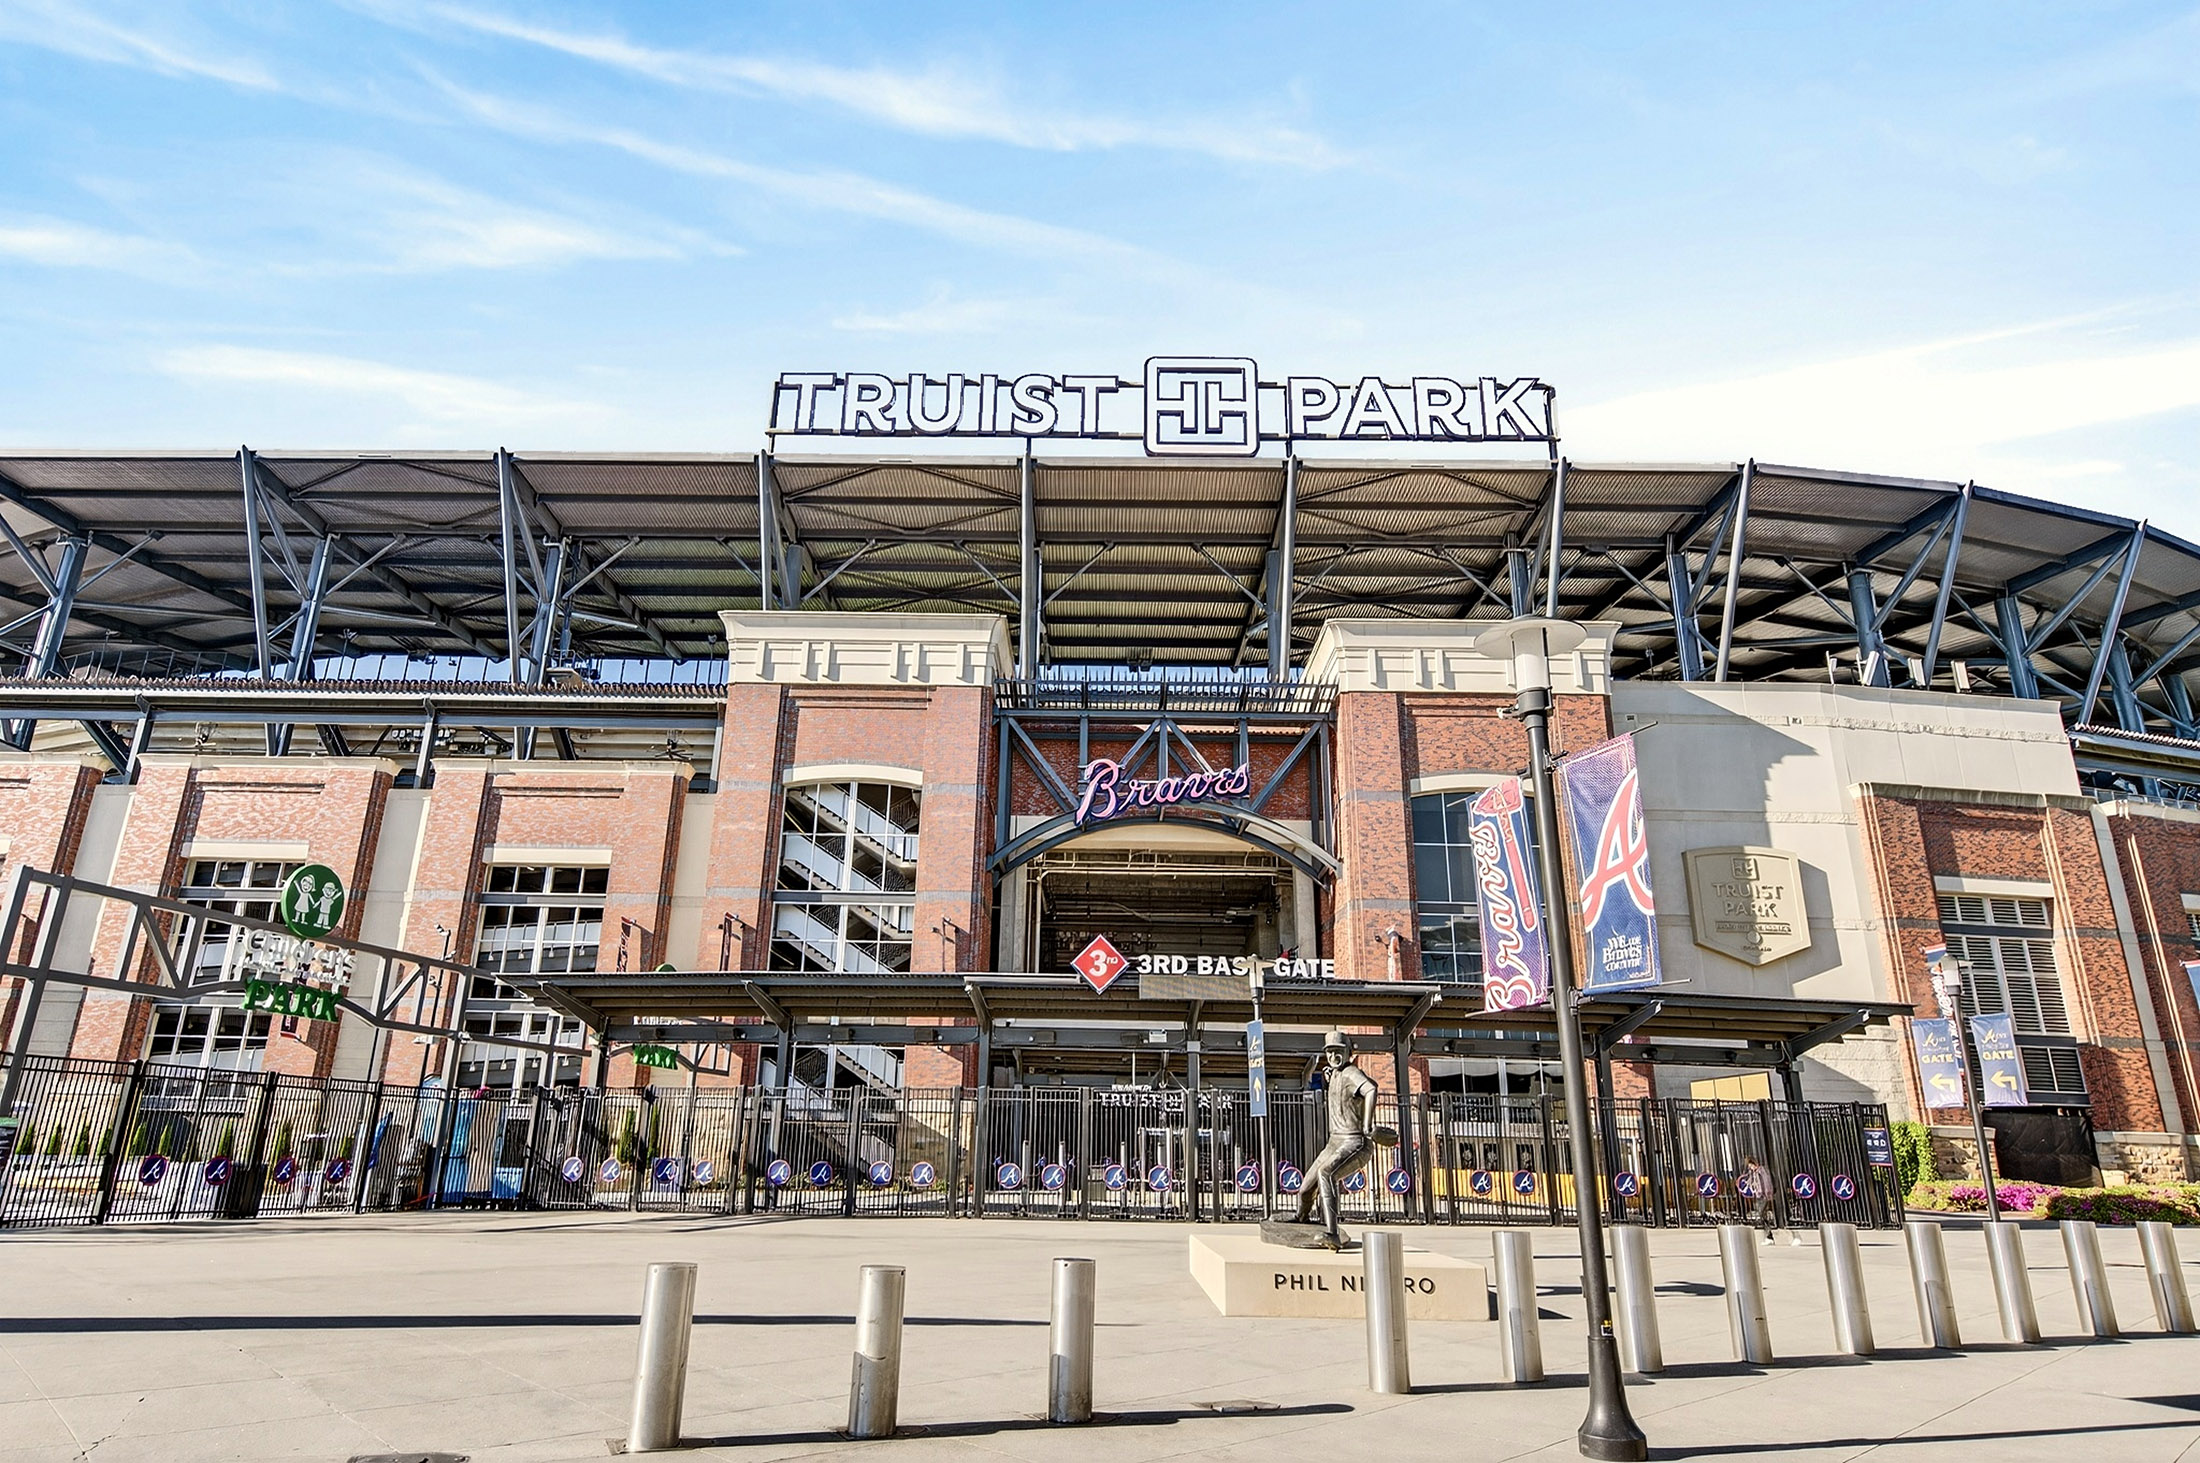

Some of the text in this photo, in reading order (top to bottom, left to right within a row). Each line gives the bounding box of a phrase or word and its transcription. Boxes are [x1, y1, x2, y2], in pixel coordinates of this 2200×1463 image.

[780, 371, 1548, 442] TRUIST PARK
[1075, 758, 1250, 826] Braves
[1579, 767, 1656, 933] A
[1713, 883, 1784, 900] TRUIST
[1469, 820, 1538, 1013] Braves
[1724, 901, 1778, 918] PARK
[1137, 954, 1334, 979] 3RD BAS GATE
[242, 978, 344, 1022] PARK
[1921, 1053, 1954, 1064] GATE
[1983, 1049, 2015, 1061] GATE
[1274, 1273, 1436, 1295] PHIL NIRO
